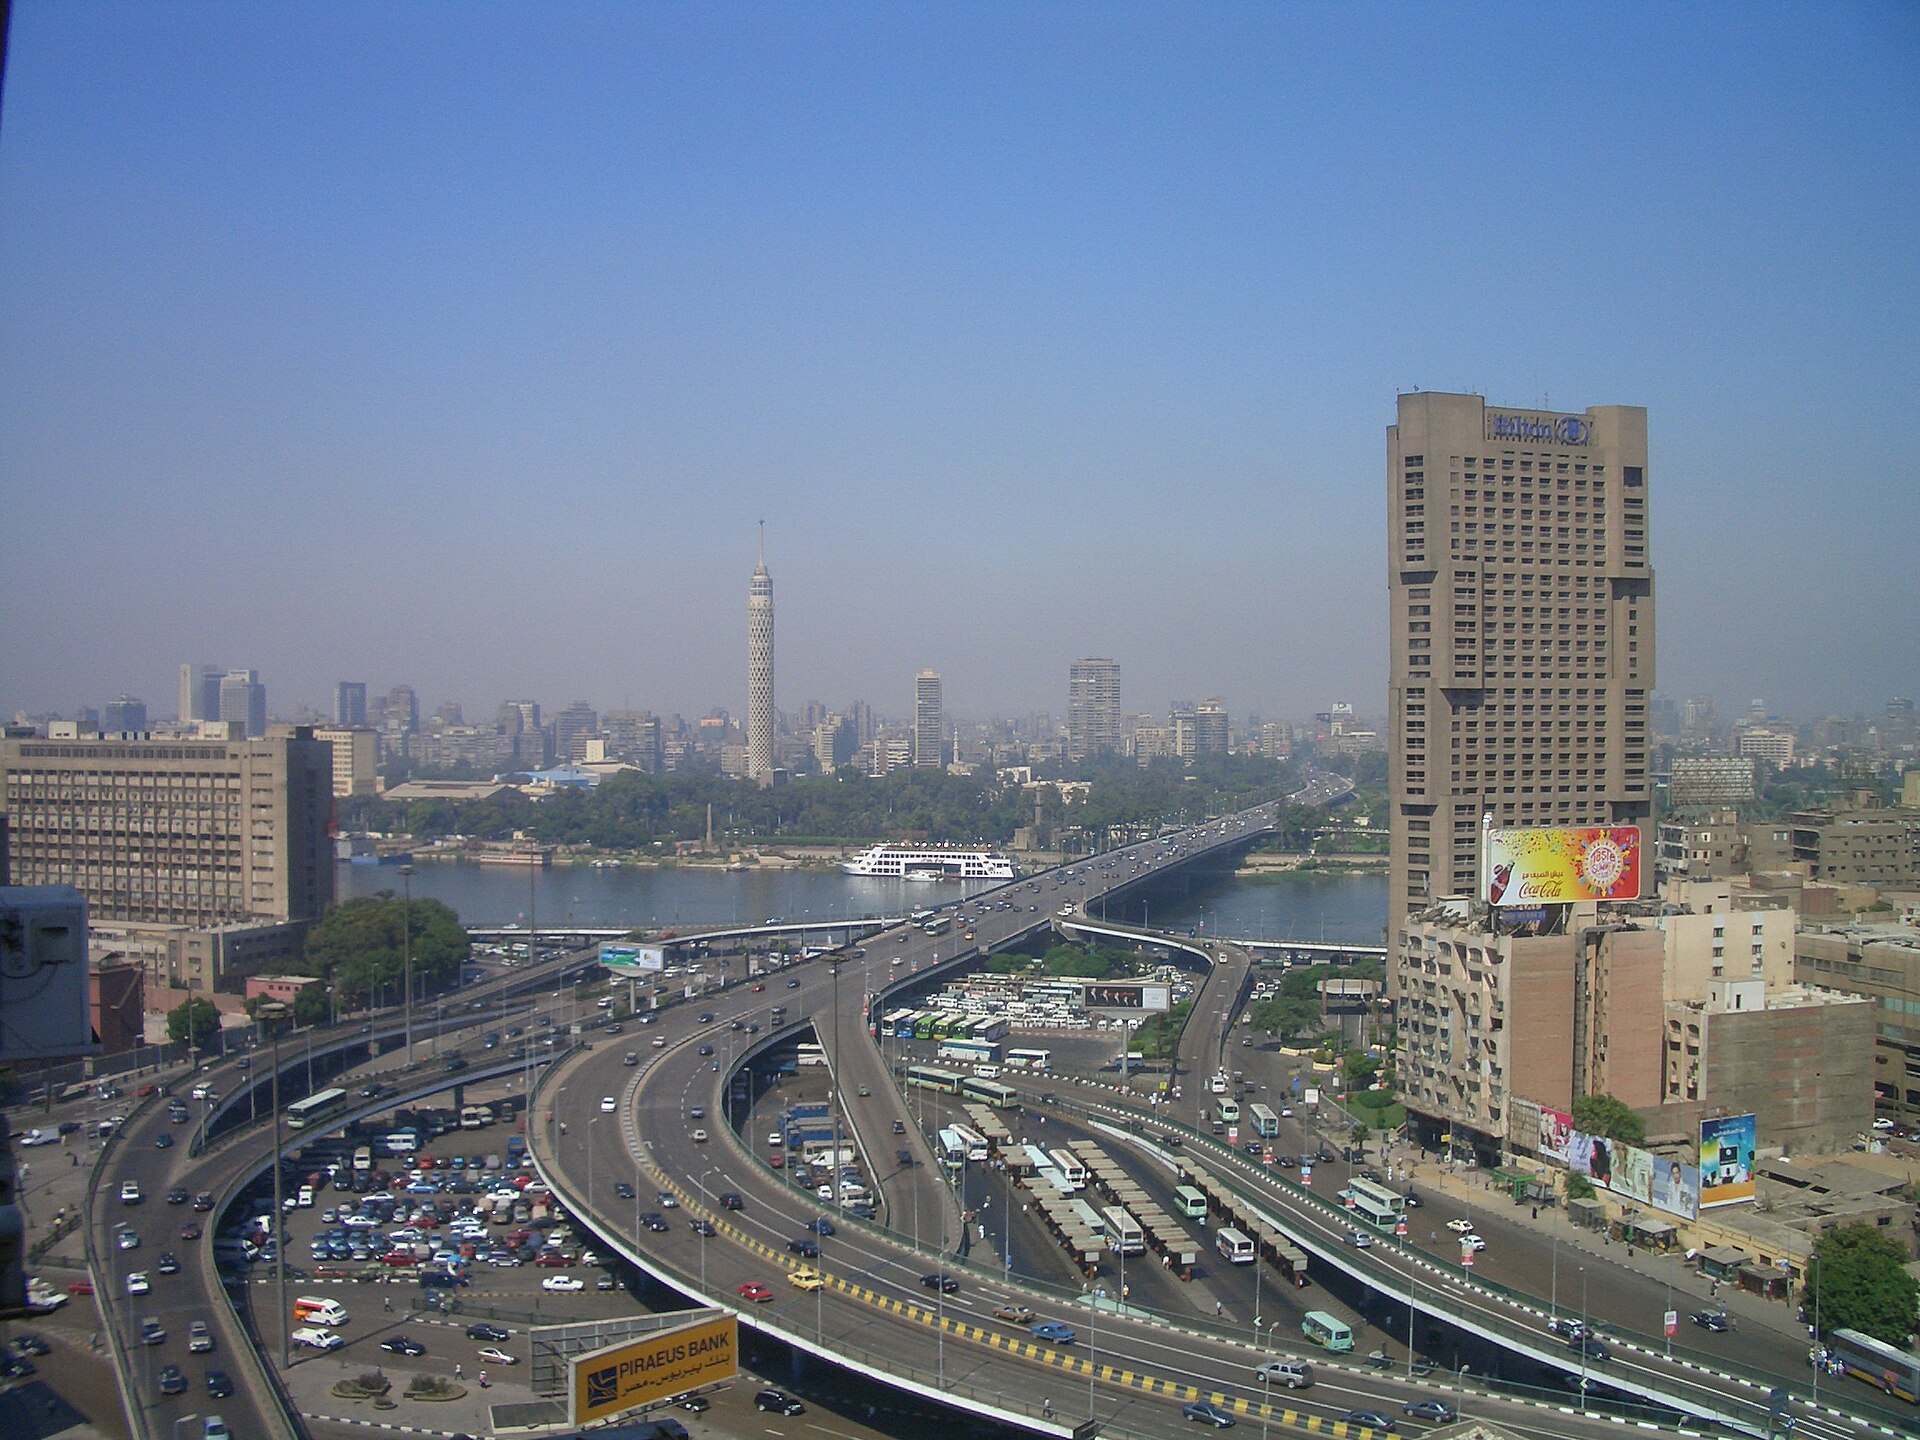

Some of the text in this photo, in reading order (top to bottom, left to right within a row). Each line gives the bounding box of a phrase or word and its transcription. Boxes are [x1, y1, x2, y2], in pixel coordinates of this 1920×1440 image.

[1494, 414, 1553, 437] Hilton
[619, 1331, 729, 1378] PIRAEUS BANK
